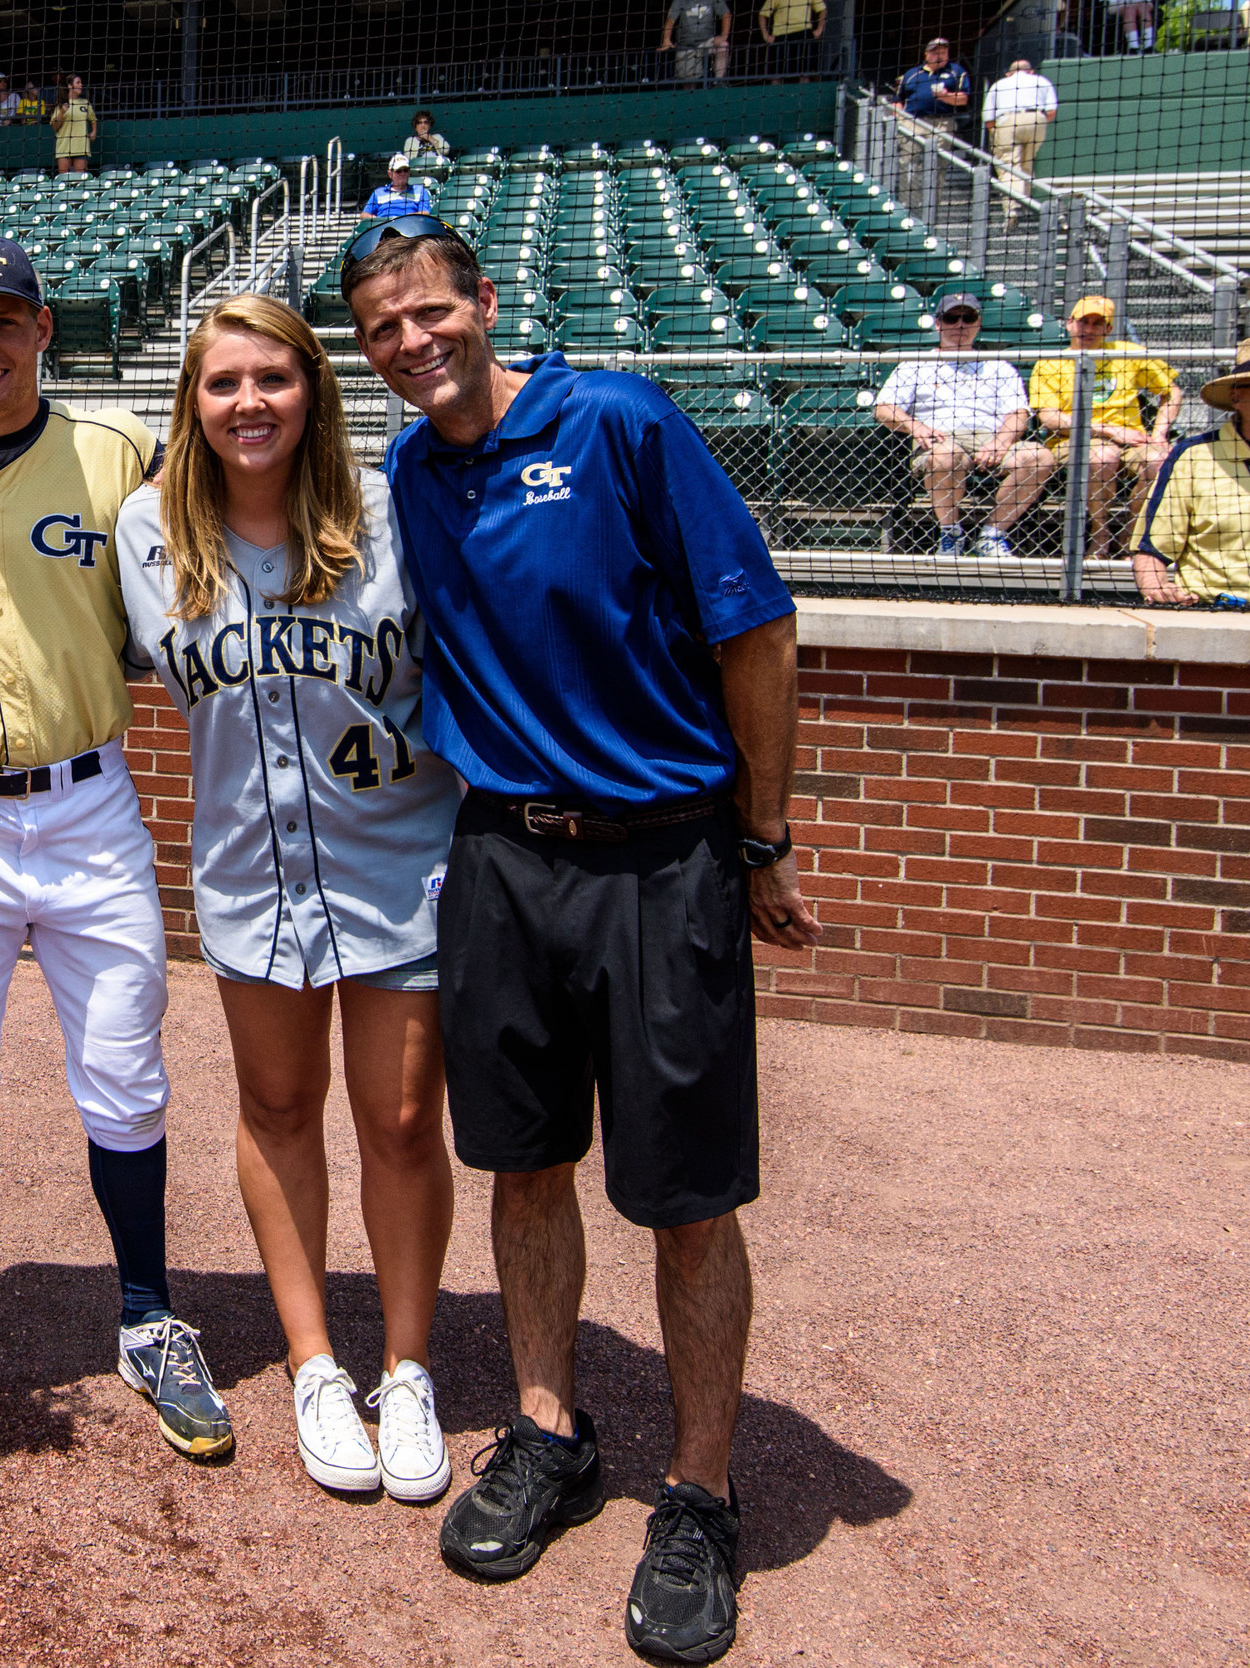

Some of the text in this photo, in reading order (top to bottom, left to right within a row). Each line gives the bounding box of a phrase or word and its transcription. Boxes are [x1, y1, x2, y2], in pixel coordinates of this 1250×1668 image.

[521, 461, 572, 487] GT
[523, 487, 571, 506] Baseball
[30, 513, 108, 568] GT
[159, 615, 404, 710] JACKETS
[327, 714, 417, 792] 41
